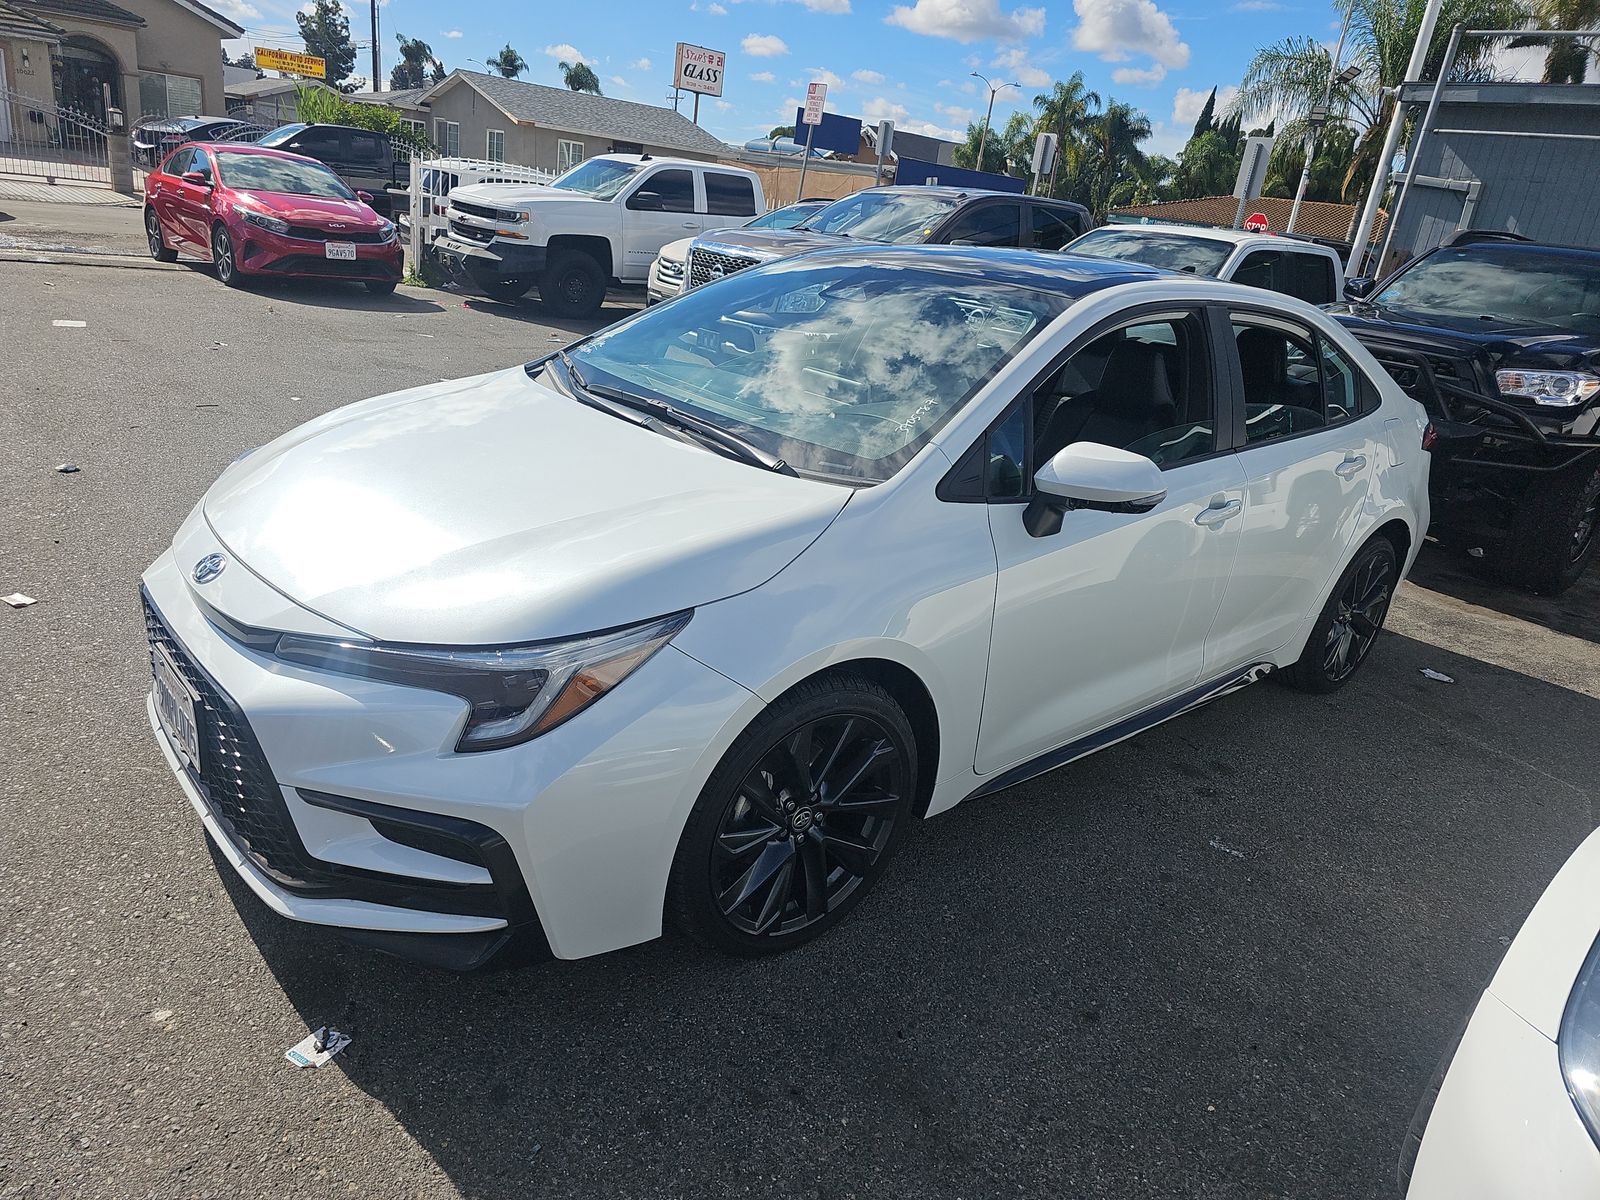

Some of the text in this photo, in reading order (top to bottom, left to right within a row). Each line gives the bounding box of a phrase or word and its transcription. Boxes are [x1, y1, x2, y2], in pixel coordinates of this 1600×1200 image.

[257, 49, 324, 66] CALIFORNIA AUTO SERVICE
[684, 49, 707, 63] STAR'S
[302, 69, 323, 77] TOYOTA
[683, 63, 721, 83] GLASS
[1246, 221, 1267, 231] STOP
